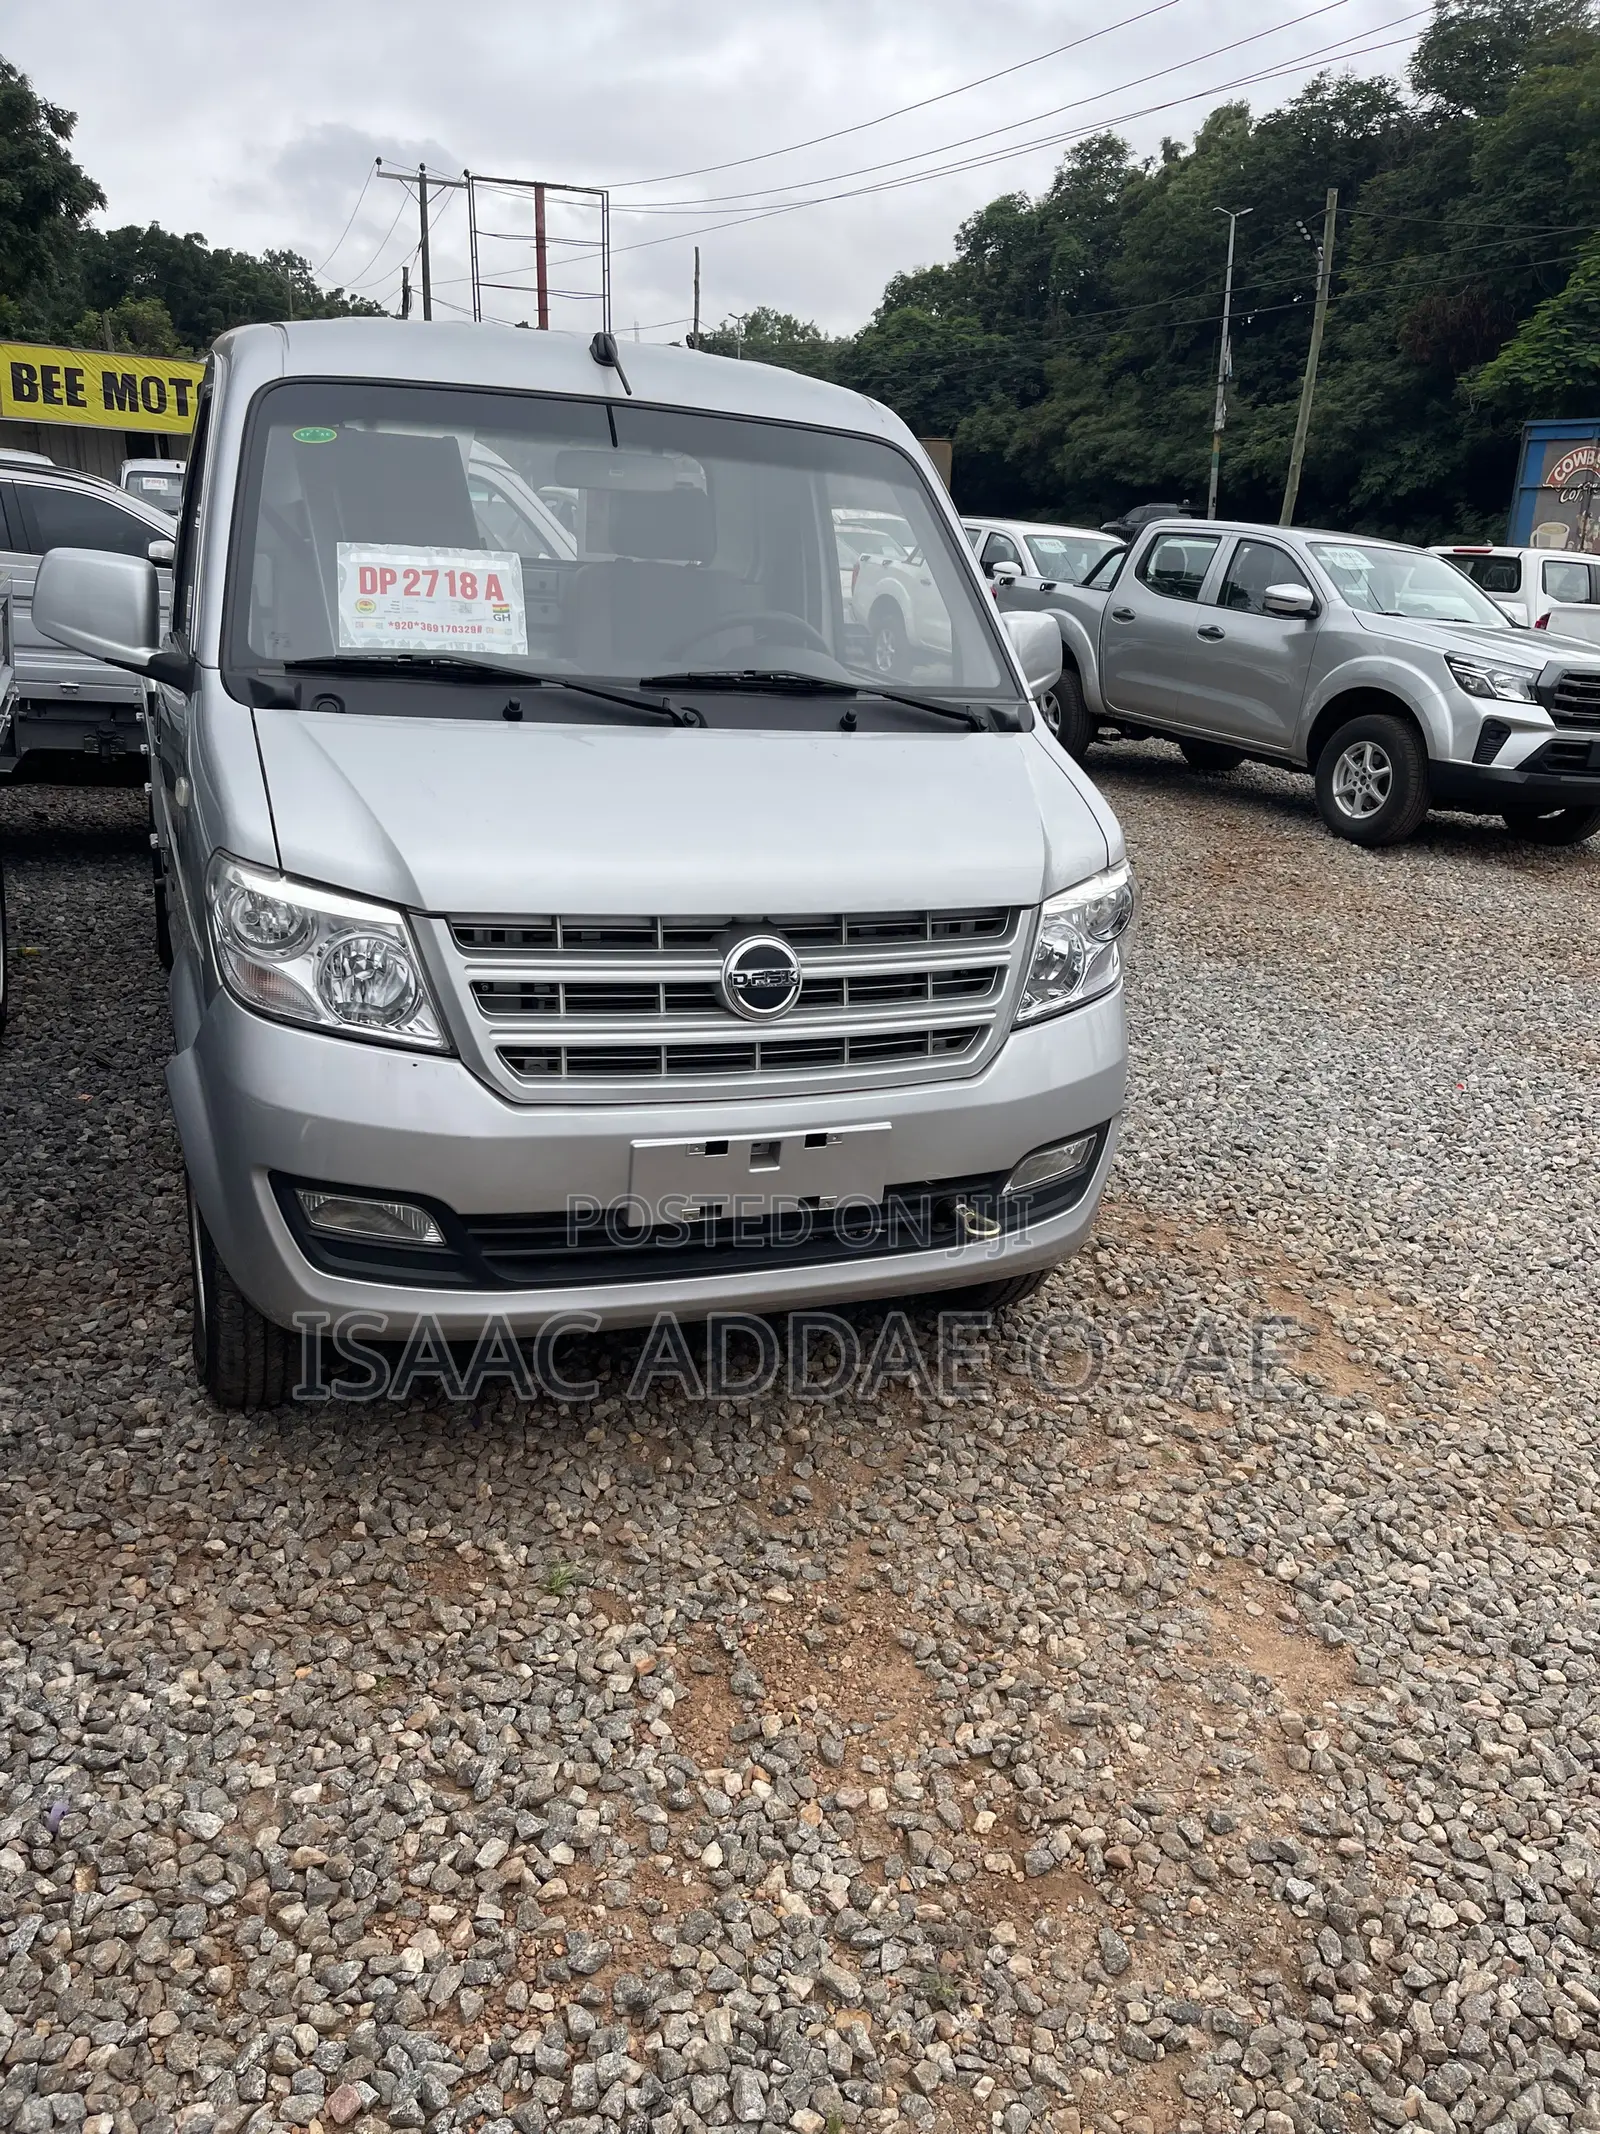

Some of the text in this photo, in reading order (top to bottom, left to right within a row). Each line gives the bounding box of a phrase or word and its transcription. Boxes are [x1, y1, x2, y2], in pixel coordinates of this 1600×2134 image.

[10, 361, 206, 417] BEE MOT
[359, 566, 505, 601] DP 2718 A
[493, 613, 511, 622] GH
